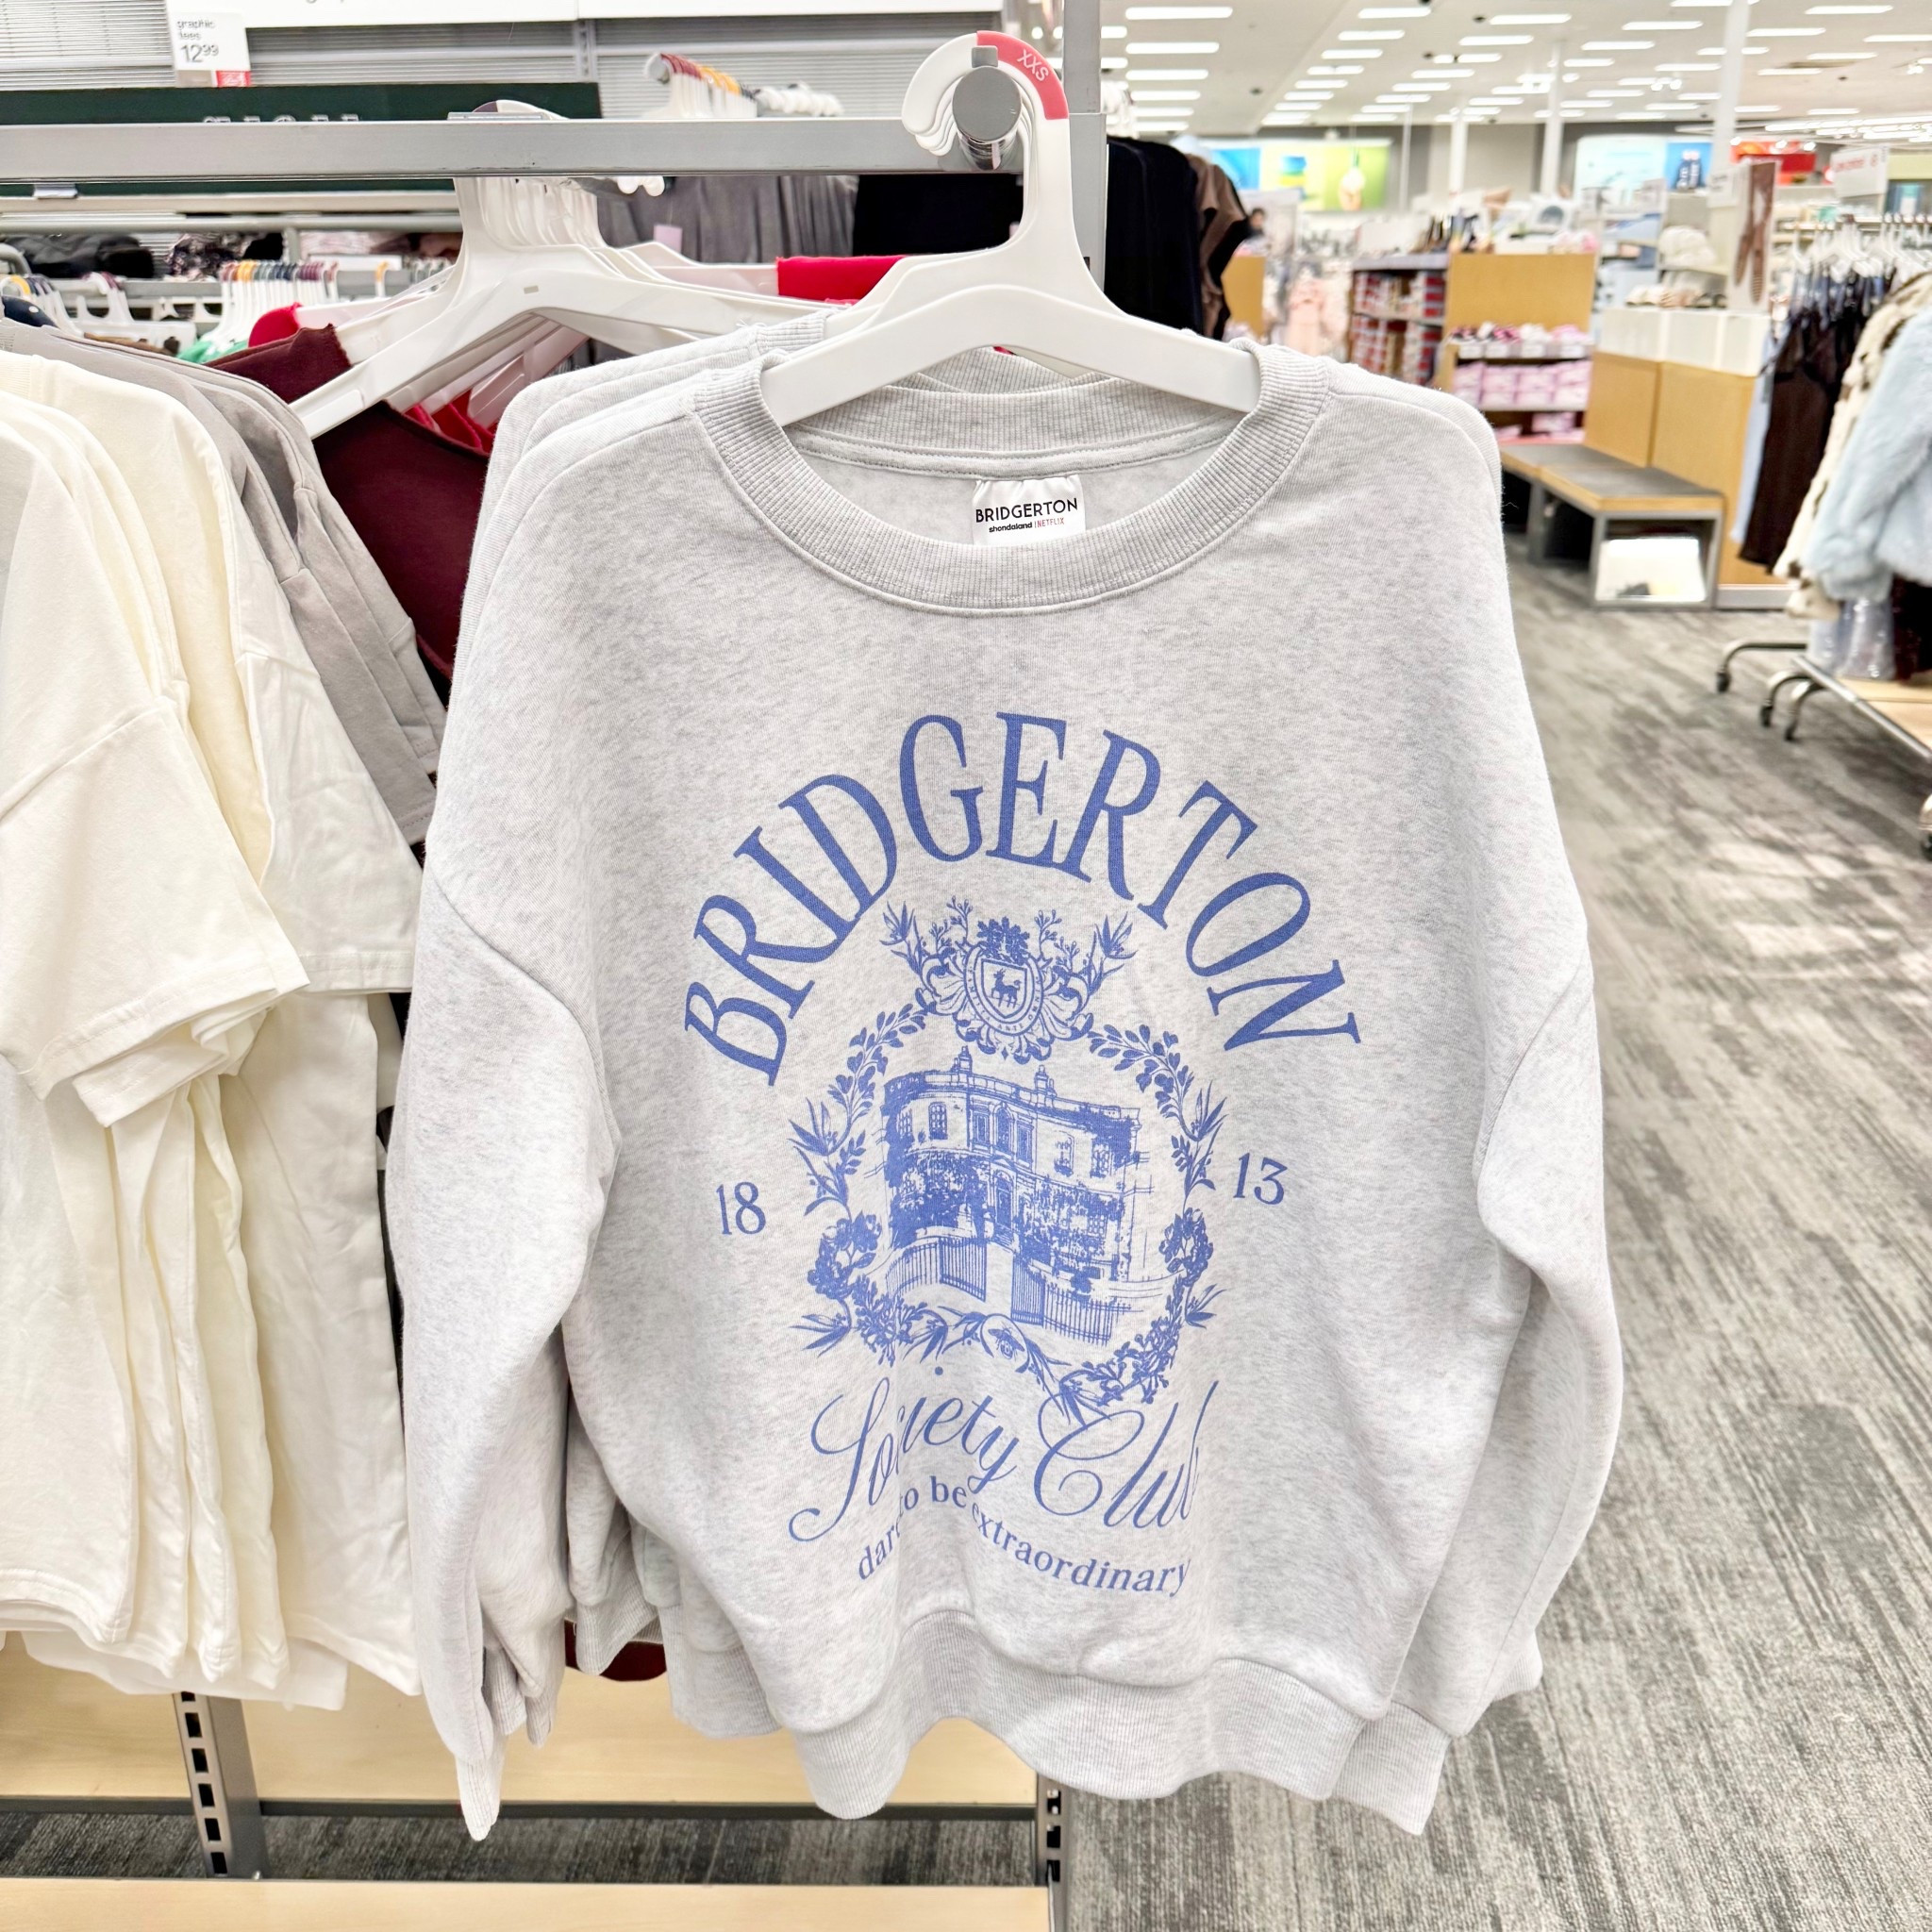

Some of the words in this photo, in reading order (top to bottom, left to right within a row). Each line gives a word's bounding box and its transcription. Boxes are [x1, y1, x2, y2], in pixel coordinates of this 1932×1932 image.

[1017, 49, 1049, 81] XXS
[975, 497, 1078, 523] BRIDGERTON
[989, 522, 1033, 533] shondaland
[1037, 517, 1065, 529] NETFLIX
[684, 711, 1361, 1087] BRIDGERTON
[715, 1181, 767, 1236] 18
[1232, 1152, 1289, 1207] 13
[1034, 1380, 1219, 1529] Club
[930, 1475, 967, 1508] be
[972, 1503, 1191, 1597] extraordinary
